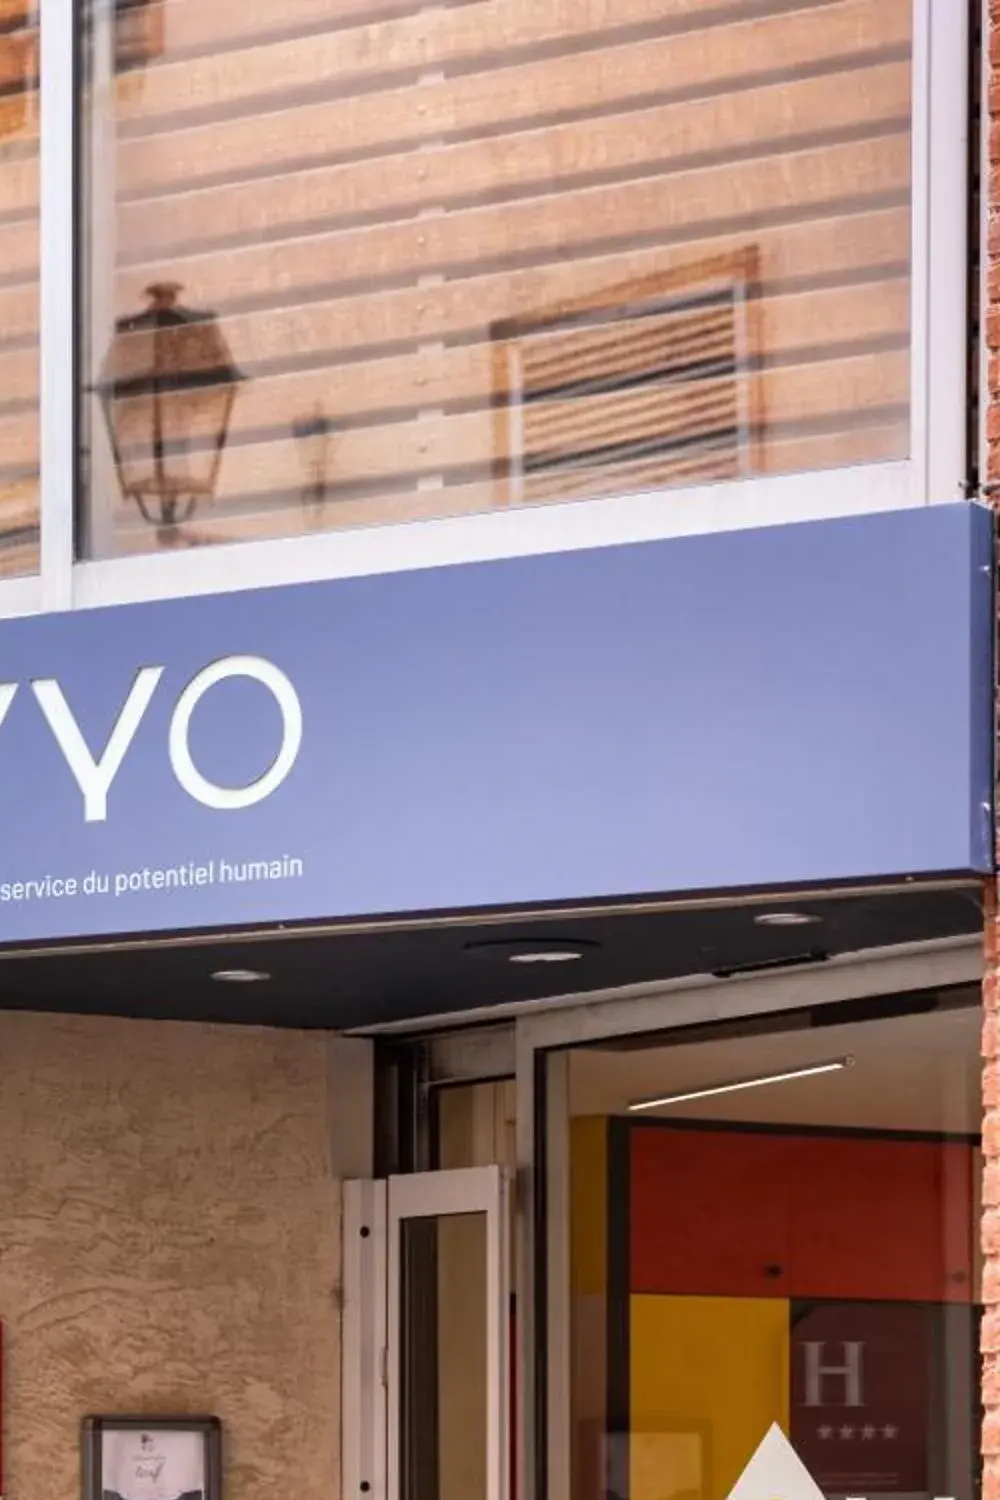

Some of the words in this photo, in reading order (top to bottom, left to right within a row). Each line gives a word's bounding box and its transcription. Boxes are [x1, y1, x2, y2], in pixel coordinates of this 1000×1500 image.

[0, 875, 78, 902] service
[83, 869, 110, 895] du
[114, 859, 215, 897] potentiel
[218, 854, 304, 884] humain
